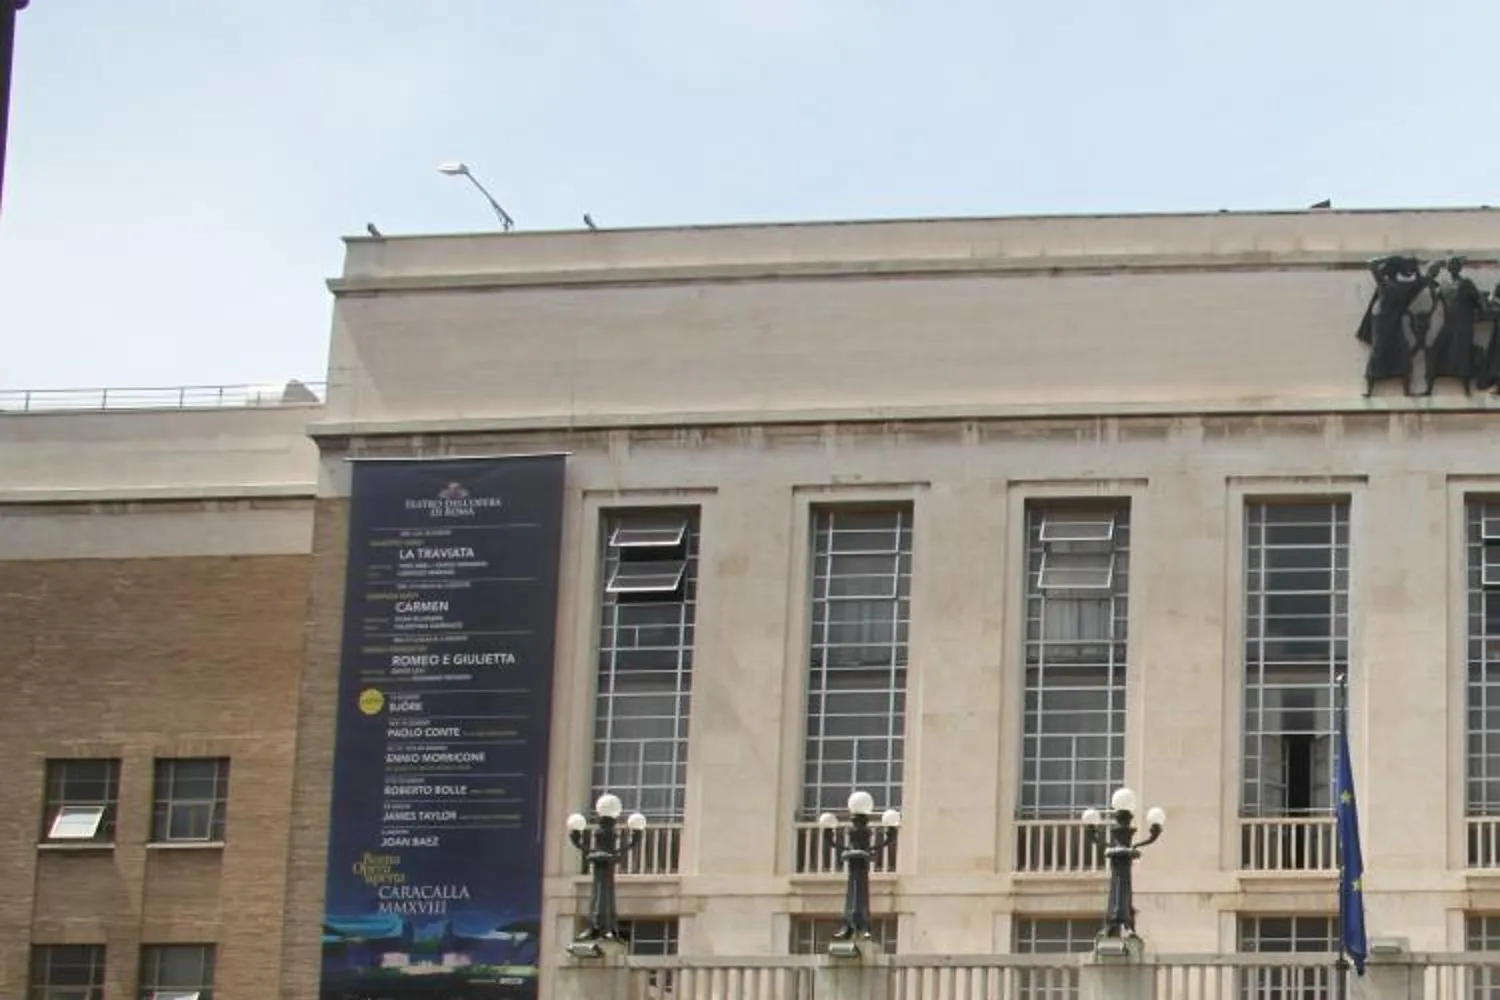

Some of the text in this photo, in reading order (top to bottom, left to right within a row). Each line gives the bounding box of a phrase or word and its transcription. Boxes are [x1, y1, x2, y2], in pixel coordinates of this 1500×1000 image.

[399, 547, 475, 560] LA TRAVIATA
[394, 601, 449, 613] CARMEN
[391, 653, 516, 666] ROMEO E GIULIETTA
[424, 726, 461, 737] CONTE
[378, 884, 471, 901] CARACALLA
[378, 900, 447, 915] MMXVIII
